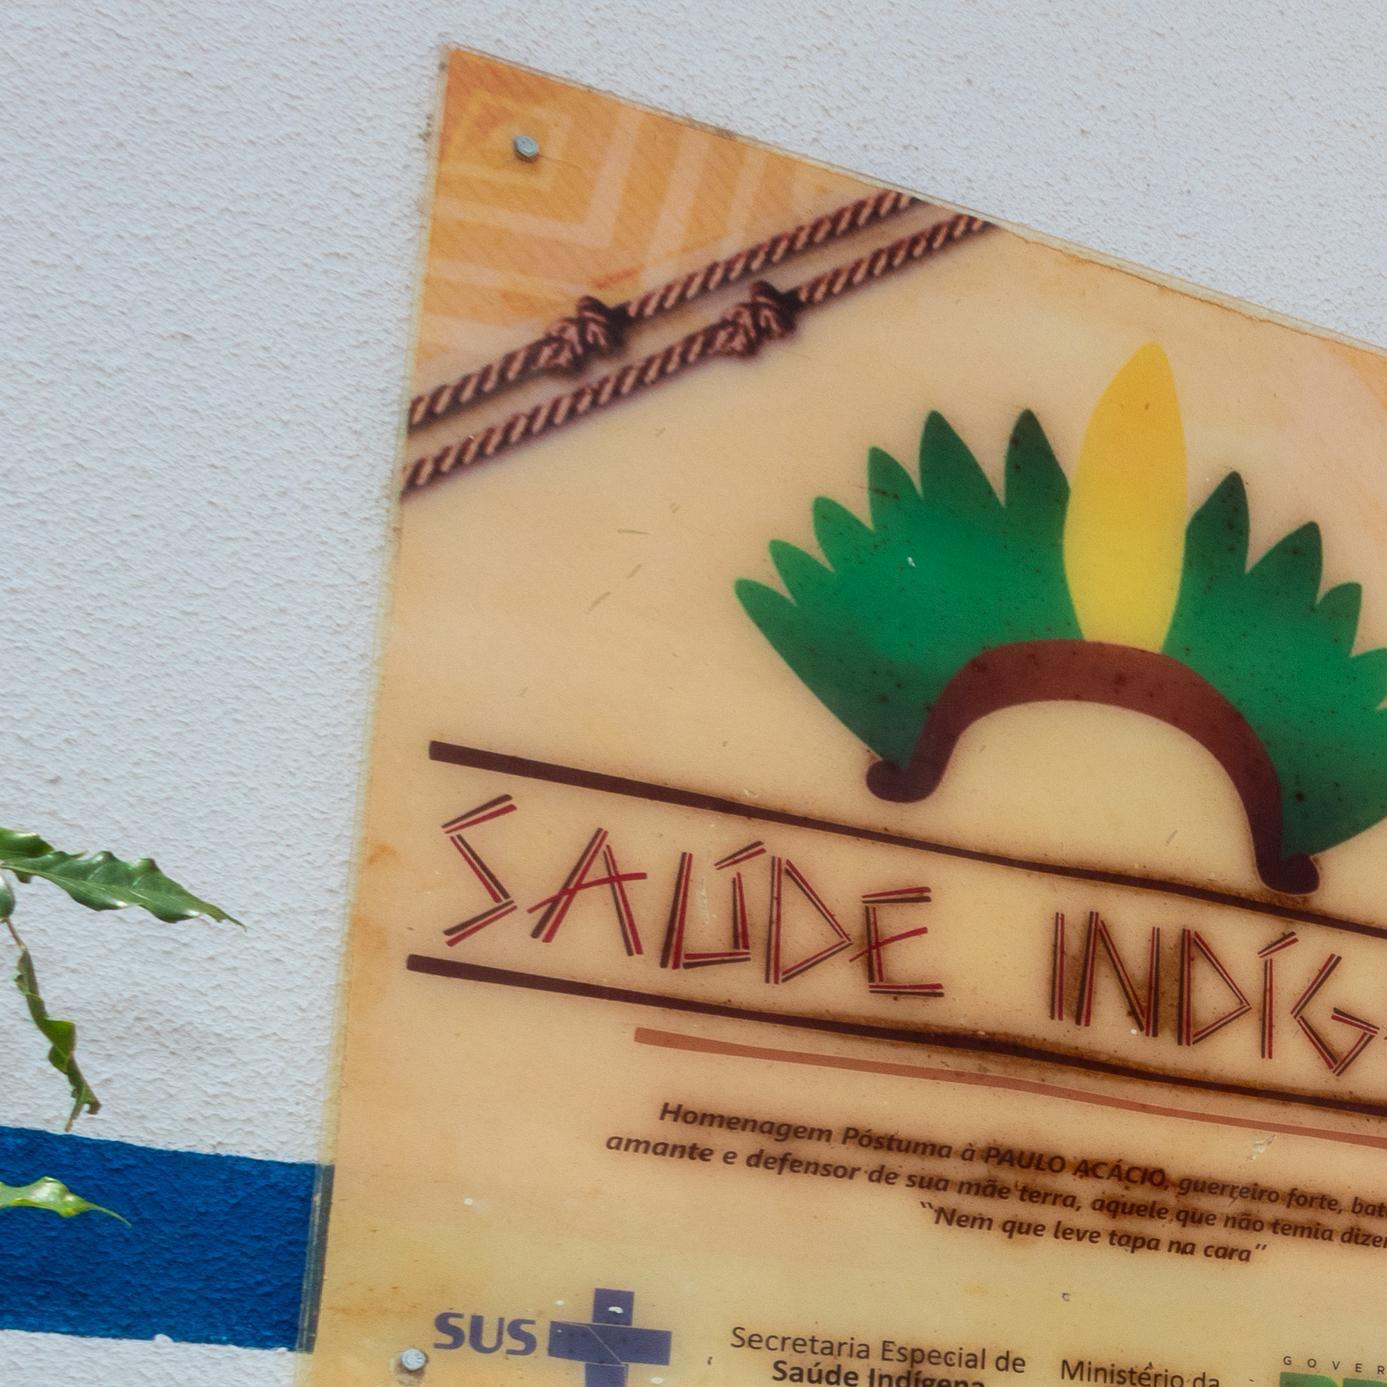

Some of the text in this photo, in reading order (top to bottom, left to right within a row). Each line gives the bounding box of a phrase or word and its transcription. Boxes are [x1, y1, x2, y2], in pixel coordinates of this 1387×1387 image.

[442, 793, 946, 999] SAÚDE
[658, 1101, 833, 1142] Homenagem
[841, 1126, 953, 1159] Póstuma
[959, 1142, 977, 1162] à
[983, 1145, 1067, 1174] PAULO
[1071, 1158, 1170, 1191] ACÁCIO,
[1177, 1176, 1281, 1204] guerreiro
[1285, 1187, 1344, 1215] forte,
[605, 1135, 714, 1162] amante
[722, 1150, 738, 1165] e
[745, 1149, 862, 1180] defensor
[866, 1164, 899, 1186] de
[904, 1172, 950, 1192] sua
[956, 1178, 1011, 1200] mãe
[1018, 1184, 1083, 1212] terra,
[1090, 1197, 1169, 1220] aquele
[1174, 1207, 1217, 1227] que
[1223, 1211, 1265, 1233] não
[1271, 1218, 1335, 1242] temia
[1001, 1217, 1047, 1240] que
[1053, 1219, 1101, 1244] leve
[1107, 1228, 1161, 1254] tapa
[1167, 1238, 1197, 1256] na
[432, 1310, 538, 1357] SUS
[729, 1325, 1027, 1374] Secretaria Especial de
[771, 1359, 860, 1387] Saúde
